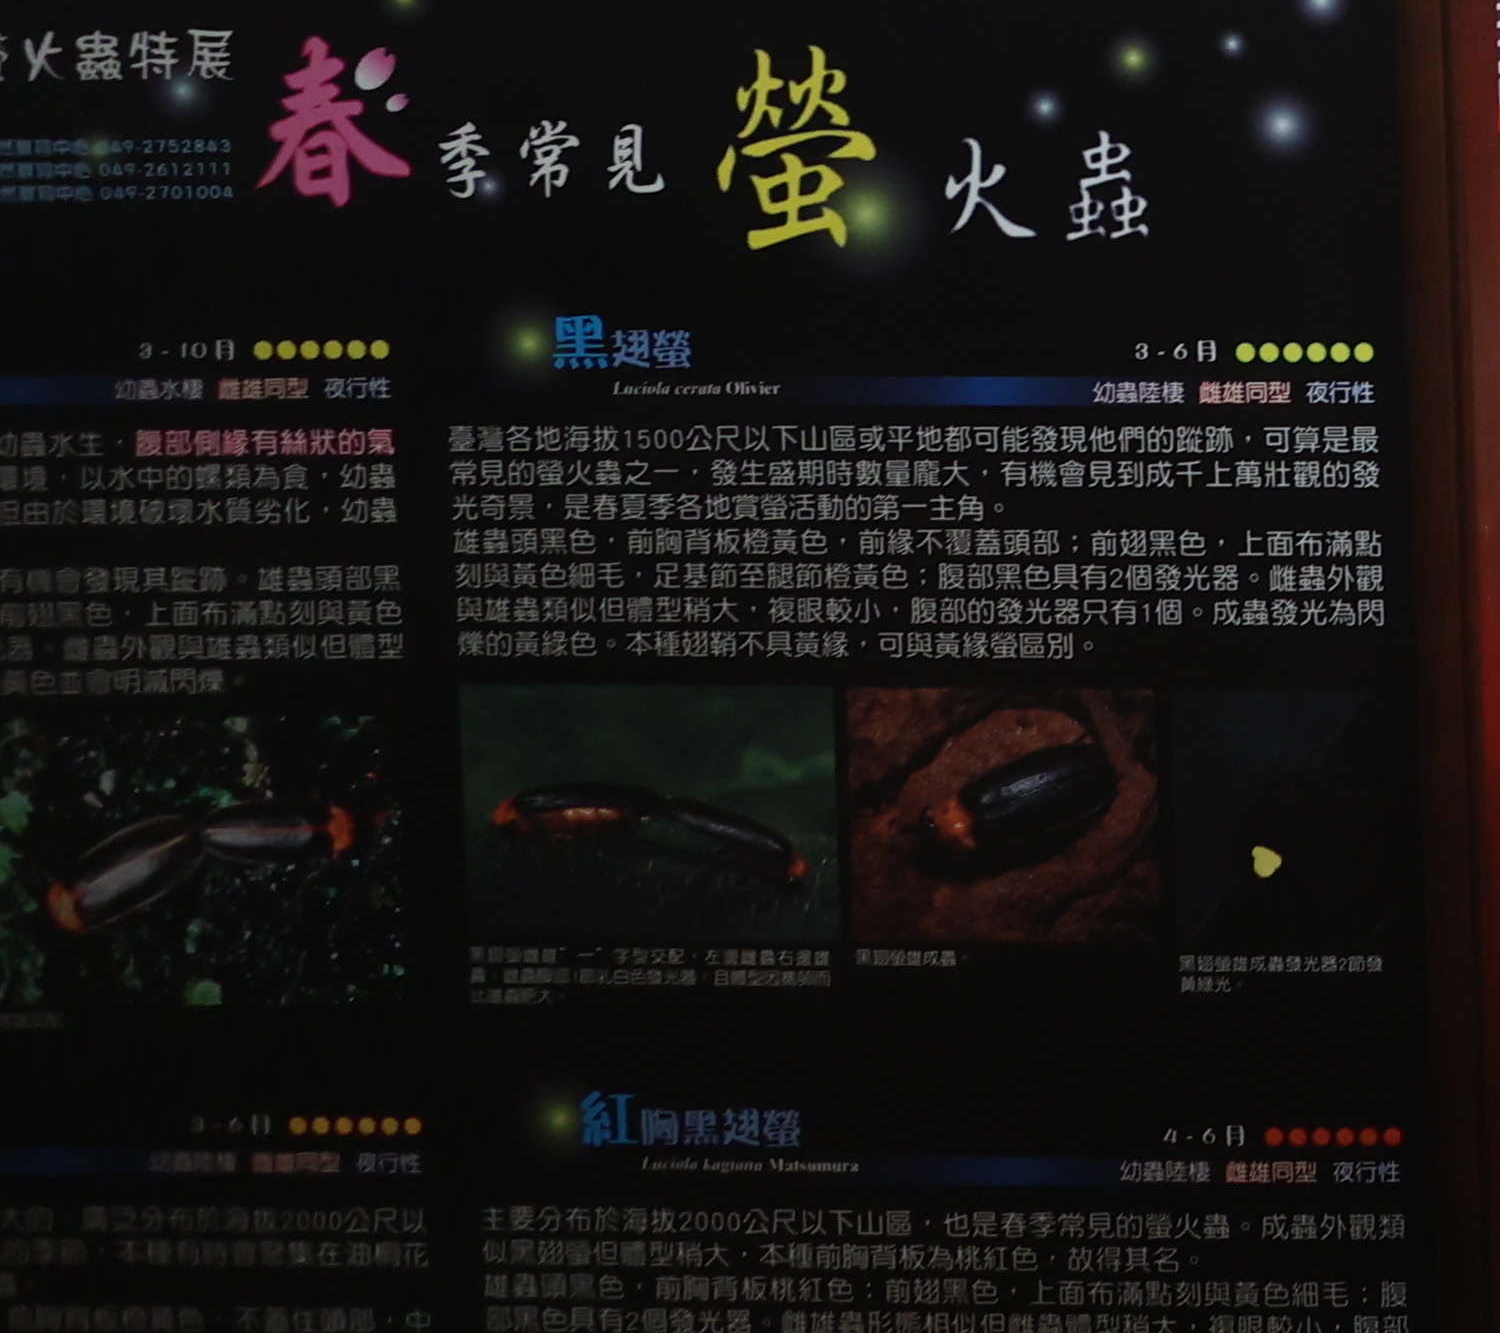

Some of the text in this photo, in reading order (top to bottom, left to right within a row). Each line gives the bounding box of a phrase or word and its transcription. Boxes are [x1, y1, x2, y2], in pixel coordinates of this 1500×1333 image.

[552, 314, 693, 371] 黑翅螢
[1133, 339, 1218, 364] 3 6 月
[725, 379, 782, 397] Olivier
[1091, 380, 1377, 406] 幼蟲陸棲 雌雄同型 夜行性
[450, 492, 1007, 523] 光奇景，是春夏季各地賞螢活動的第一主角。
[578, 1089, 802, 1150] 紅胸黑翅螢
[1331, 1159, 1402, 1185] 夜行性
